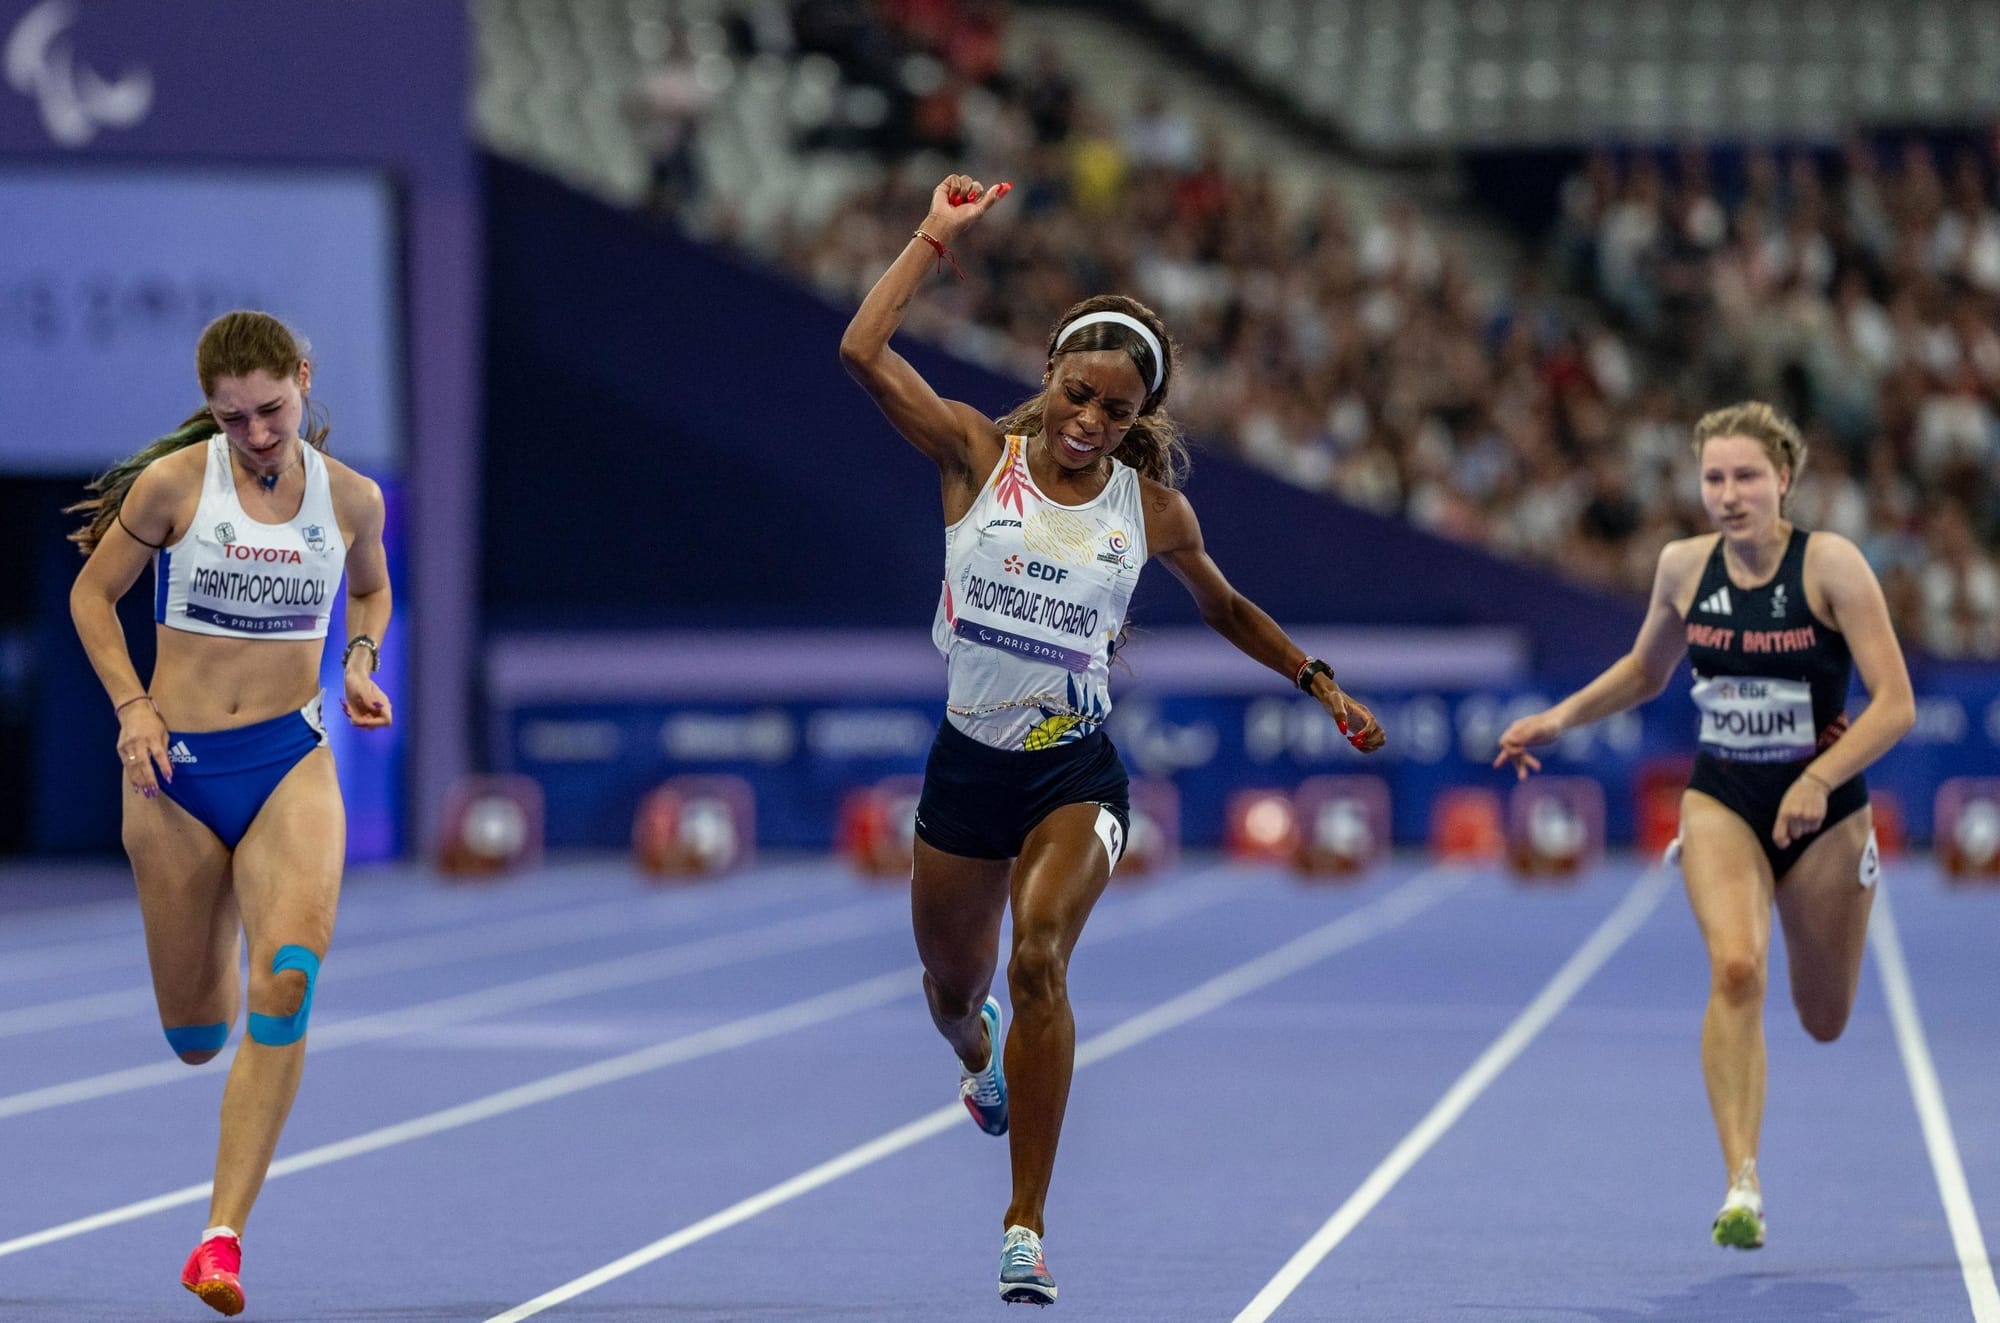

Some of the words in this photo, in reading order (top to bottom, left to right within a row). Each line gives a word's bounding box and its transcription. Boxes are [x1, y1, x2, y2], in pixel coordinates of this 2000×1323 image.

[986, 519, 1022, 529] SAETA
[223, 543, 302, 564] TOYOTA
[193, 567, 324, 605] MANTHOPOULOU
[965, 575, 1042, 624] PALOMEQUE
[1038, 595, 1098, 638] MORENO
[231, 618, 264, 629] PARIS
[267, 619, 293, 630] 2024
[996, 635, 1030, 651] PARIS
[1034, 645, 1064, 660] 2024
[1742, 624, 1816, 653] BRITAIN
[1711, 708, 1796, 736] DOWN
[168, 755, 198, 763] didas
